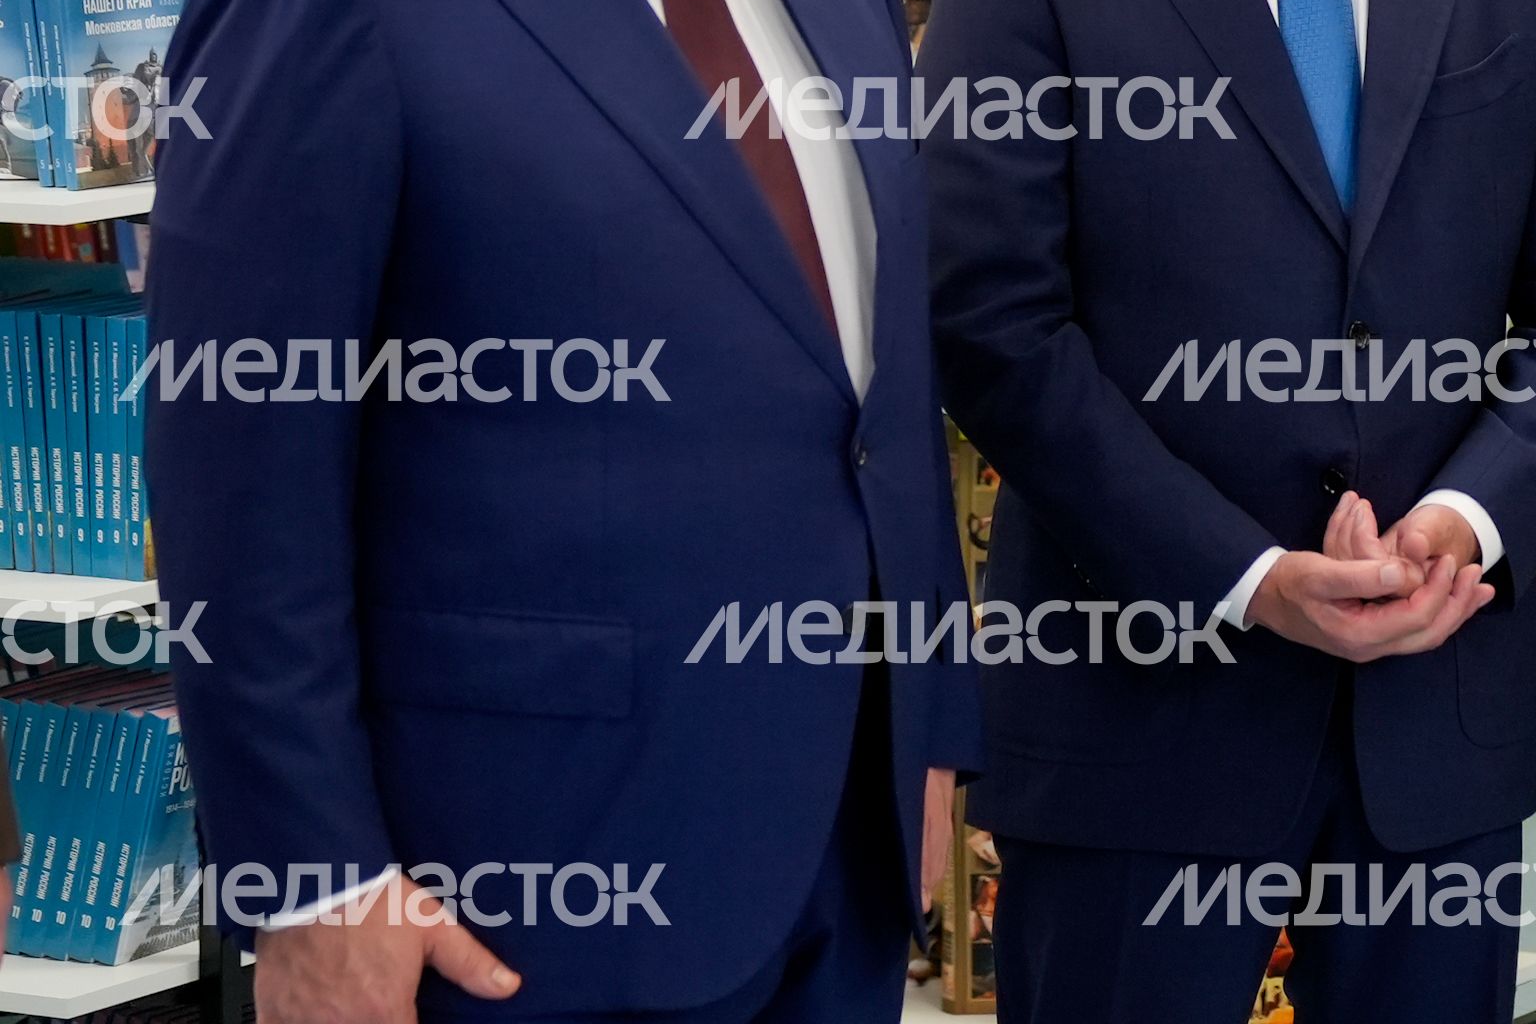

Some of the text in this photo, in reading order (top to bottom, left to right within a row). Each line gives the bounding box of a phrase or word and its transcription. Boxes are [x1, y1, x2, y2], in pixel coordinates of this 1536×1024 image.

[85, 18, 142, 36] Московская
[11, 446, 21, 479] ИСТОРИЯ
[31, 447, 40, 480] ИСТОРИЯ
[53, 448, 62, 481] ИСТОРИЯ
[74, 452, 83, 485] ИСТОРИЯ
[95, 453, 103, 486] ИСТОРИЯ
[112, 453, 120, 487] ИСТОРИЯ
[131, 456, 139, 489] ИСТОРИЯ
[14, 482, 23, 511] РОССИИ
[34, 483, 43, 512] РОССИИ
[55, 484, 64, 513] РОССИИ
[75, 488, 84, 517] РОССИИ
[96, 489, 104, 519] РОССИИ
[131, 492, 139, 522] РОССИИ
[22, 833, 35, 866] ИСТОРИЯ
[43, 836, 57, 870] ИСТОРИЯ
[67, 838, 81, 872] ИСТОРИЯ
[92, 841, 106, 875] ИСТОРИЯ
[116, 843, 130, 877] ИСТОРИЯ
[16, 867, 28, 896] РОССИИ
[36, 870, 50, 900] РОССИИ
[61, 872, 74, 902] РОССИИ
[86, 876, 99, 906] РОССИИ
[110, 878, 124, 908] РОССИИ
